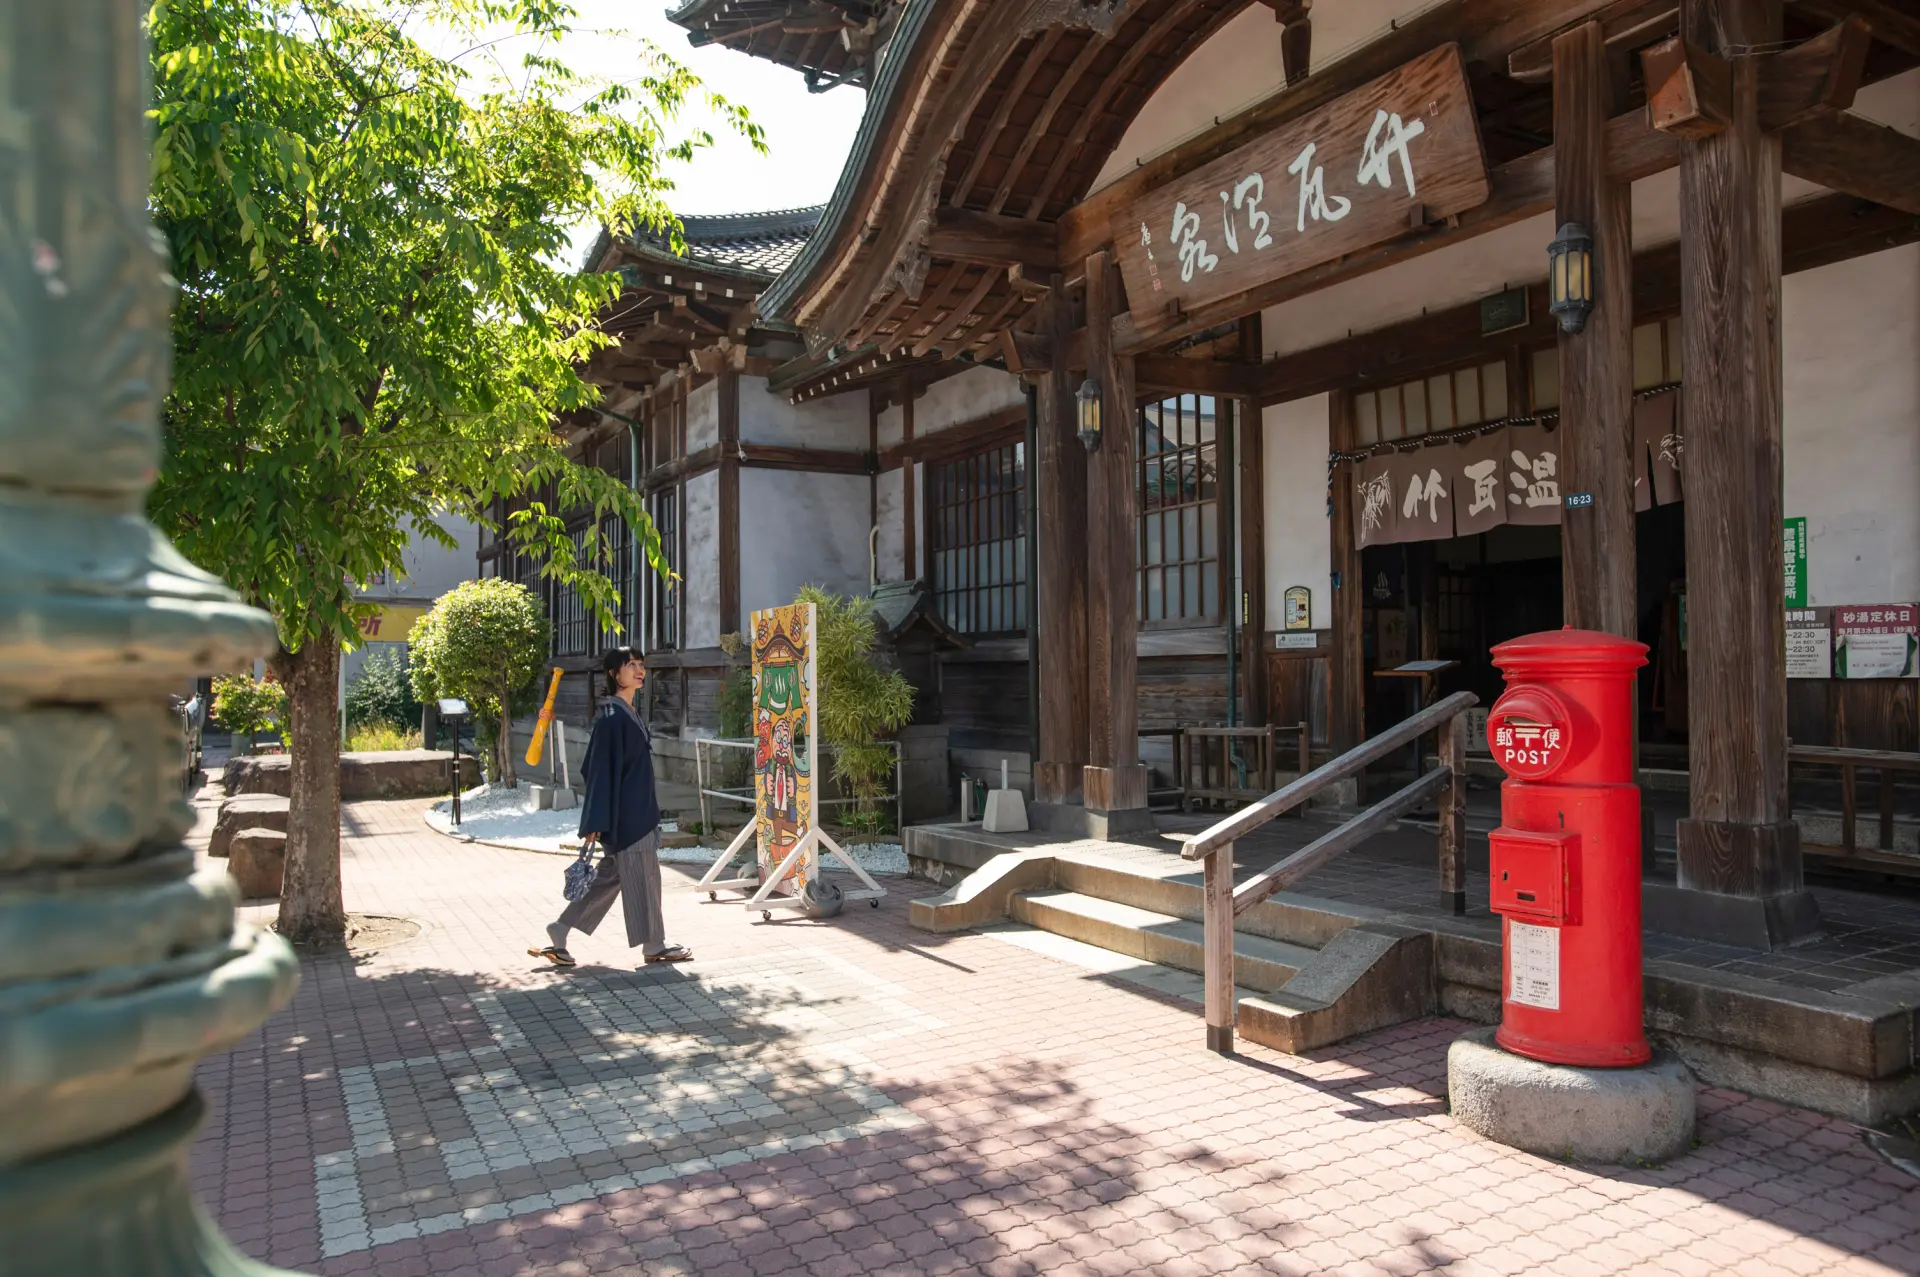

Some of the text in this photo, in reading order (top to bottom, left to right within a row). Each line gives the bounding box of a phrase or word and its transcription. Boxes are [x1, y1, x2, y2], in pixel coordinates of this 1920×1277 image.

[1843, 611, 1910, 623] 砂湯定休日
[1505, 748, 1550, 765] POST
